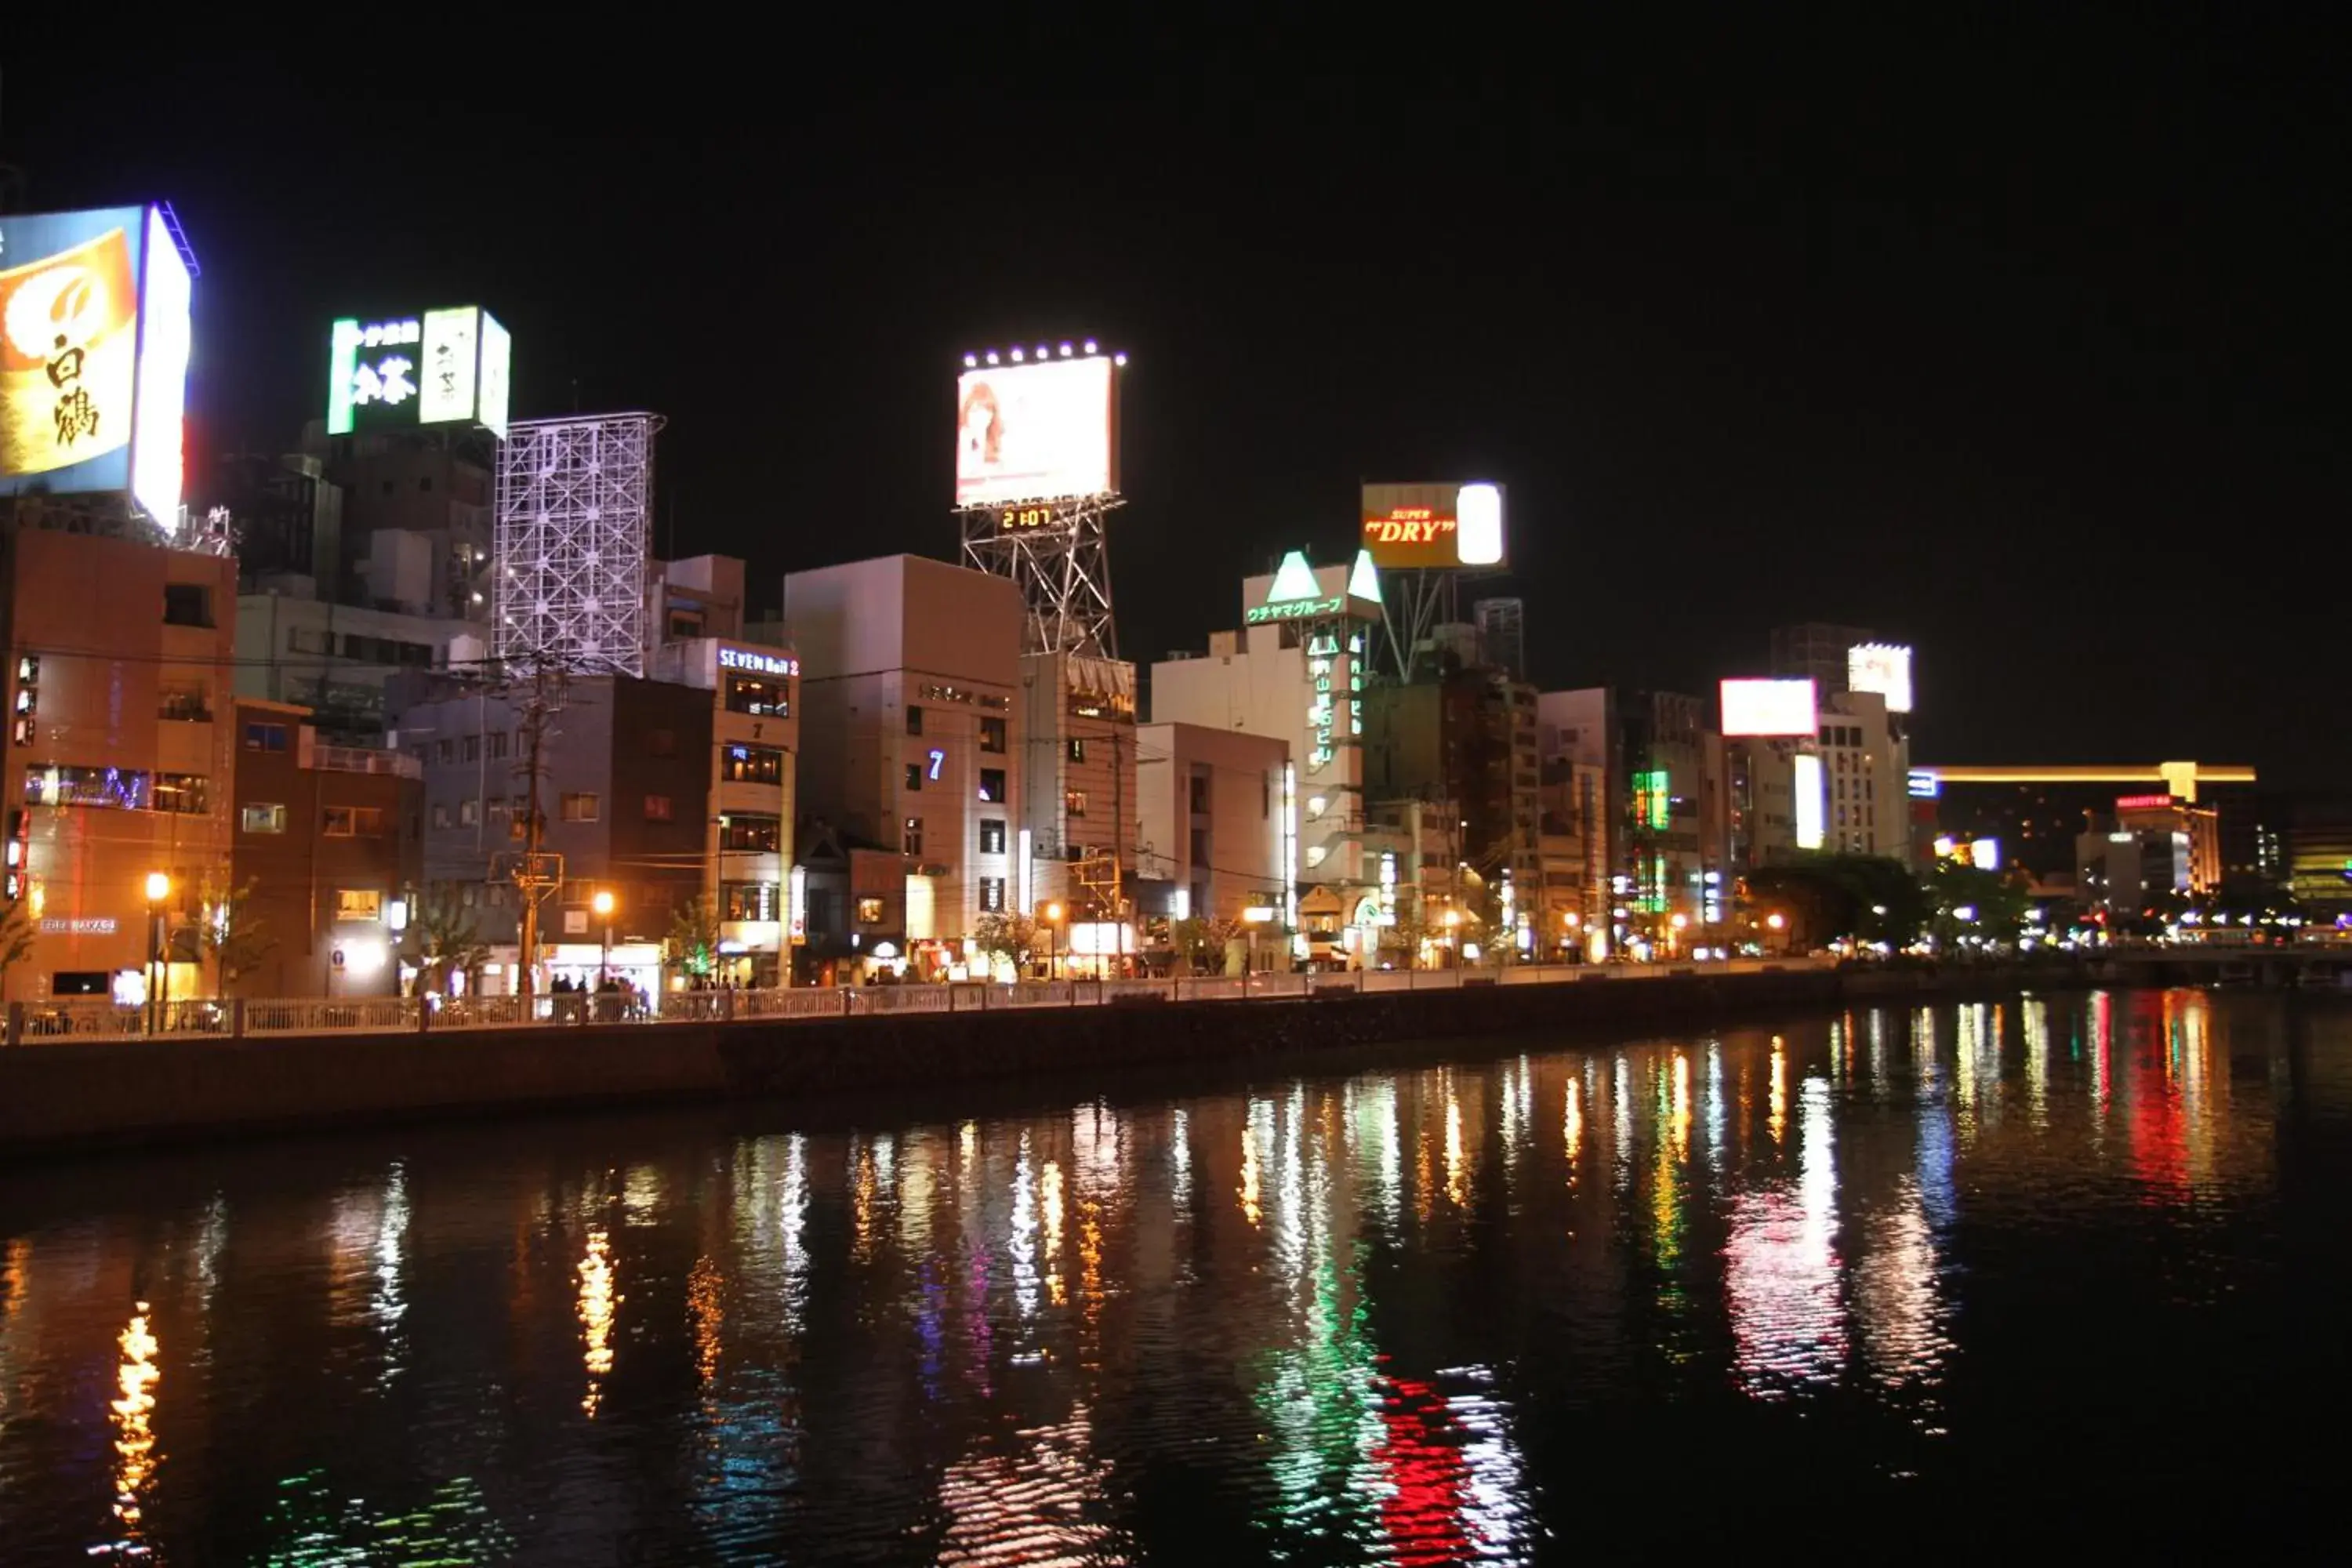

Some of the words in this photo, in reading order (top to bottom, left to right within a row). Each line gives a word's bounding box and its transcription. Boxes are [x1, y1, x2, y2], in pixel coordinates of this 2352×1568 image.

[46, 334, 99, 446] 白鶴
[1391, 509, 1431, 520] SUPER
[1247, 597, 1341, 622] ウチヤマグループ
[720, 649, 763, 670] SEVEN
[790, 660, 799, 677] 2
[930, 750, 944, 781] 7
